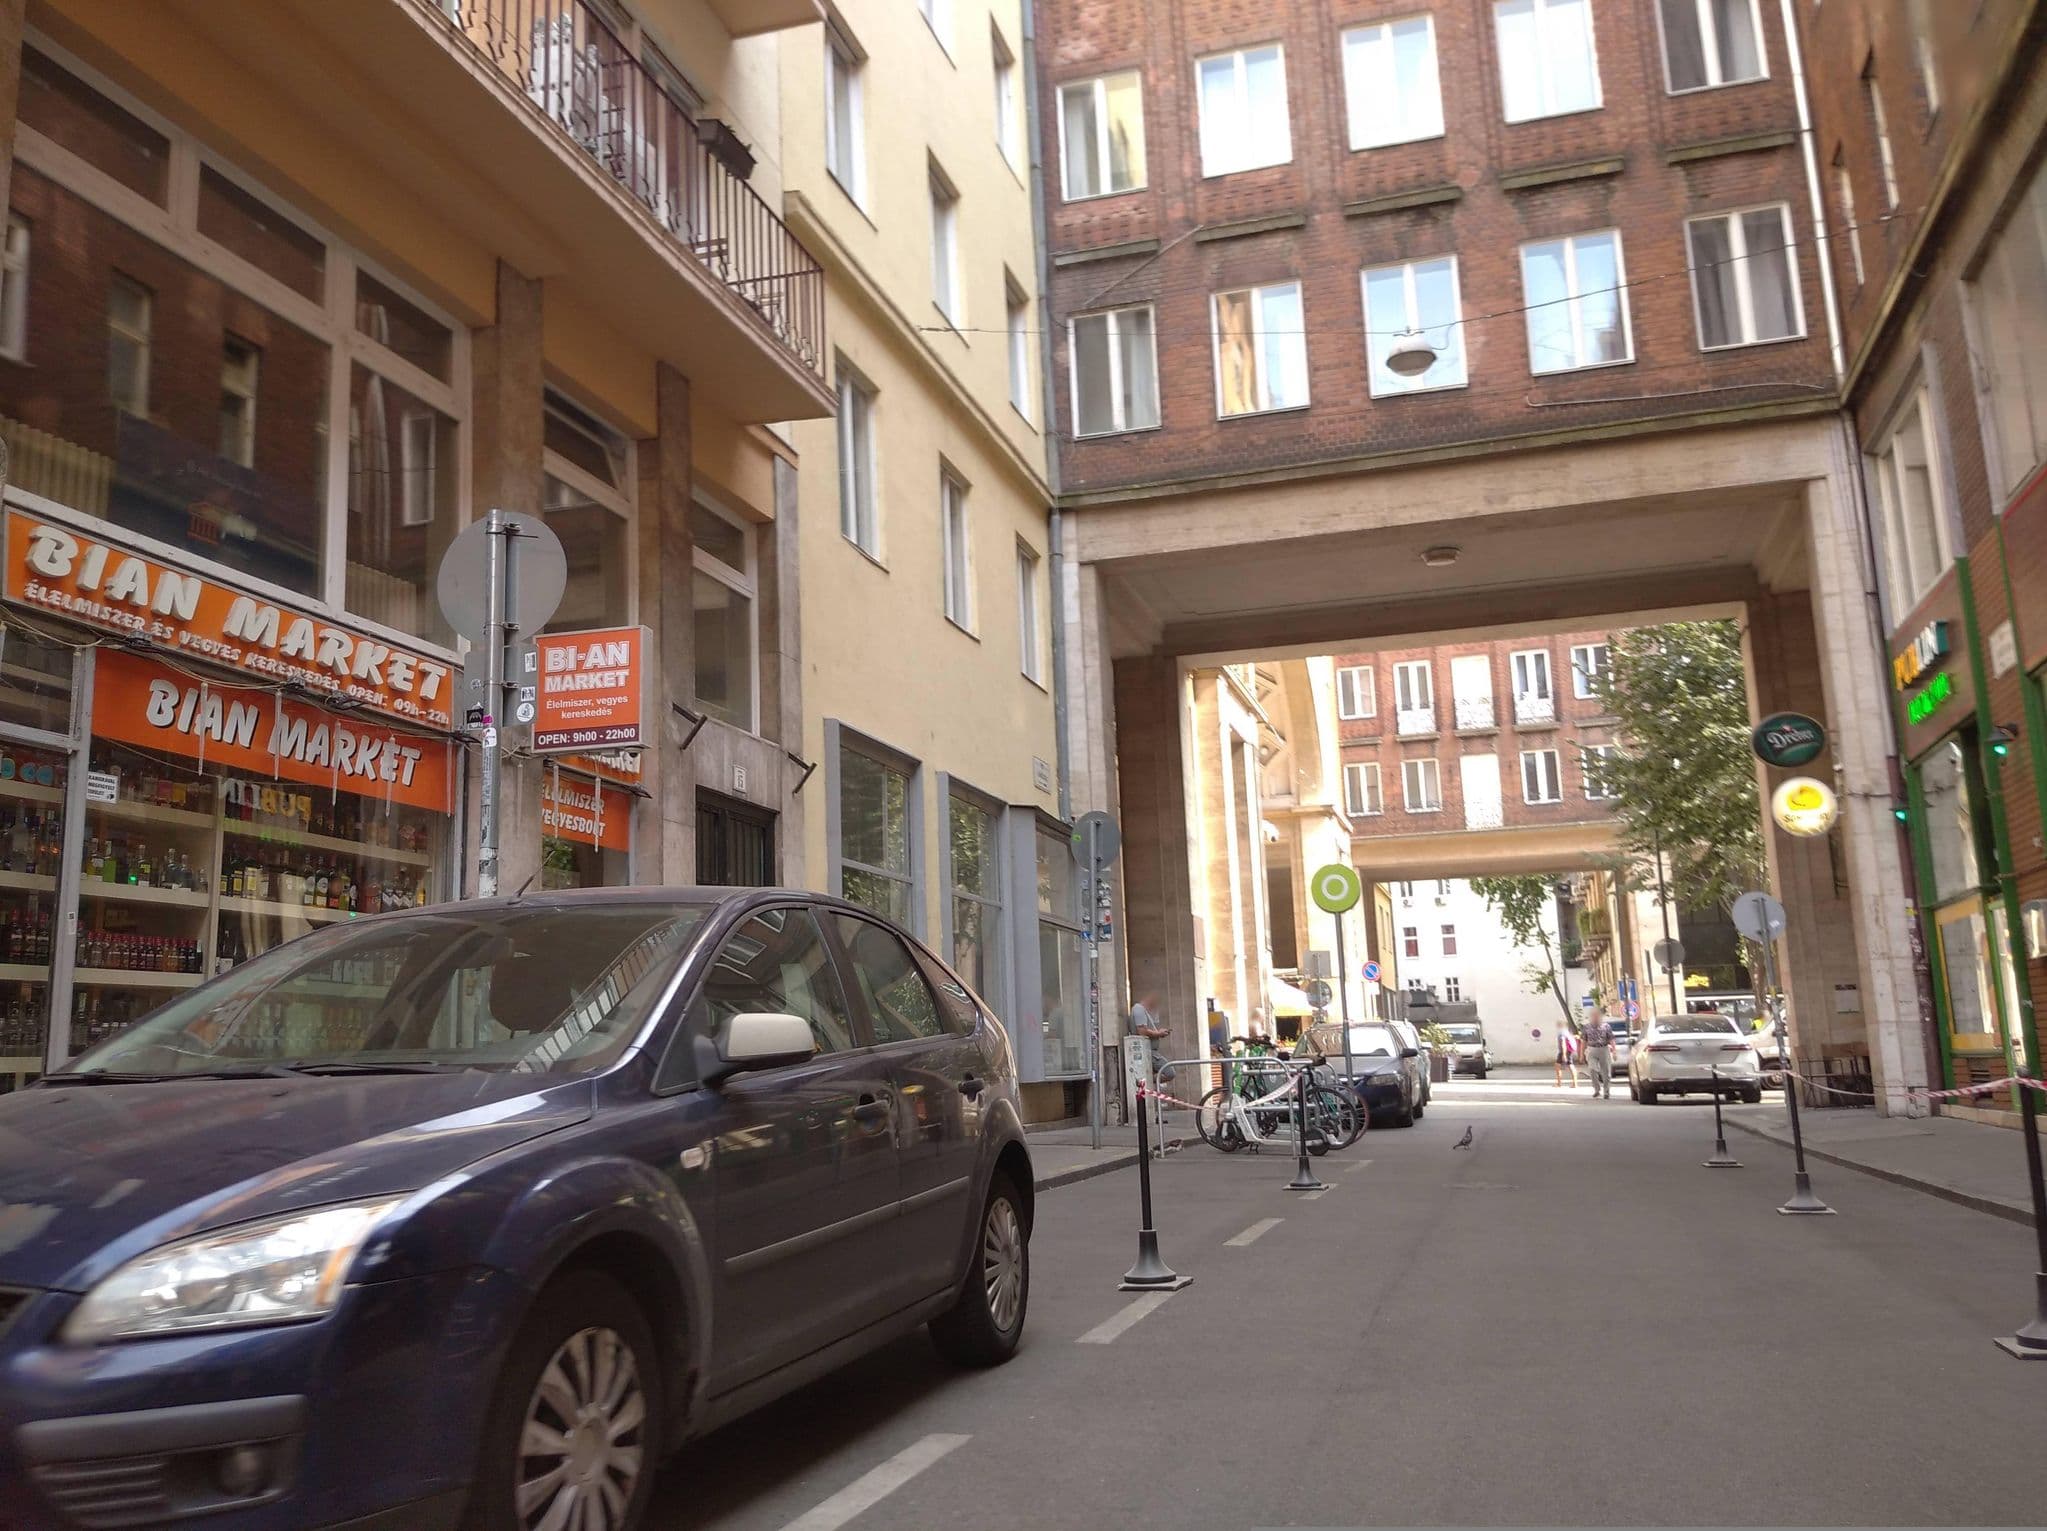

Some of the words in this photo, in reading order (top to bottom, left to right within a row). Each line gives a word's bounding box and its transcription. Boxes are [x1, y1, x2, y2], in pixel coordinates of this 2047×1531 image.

[25, 525, 202, 621] BIAN
[222, 596, 447, 700] MARKET
[544, 641, 630, 673] BI-AN
[544, 669, 630, 693] MARKET
[596, 695, 628, 706] vegyes
[146, 679, 258, 748] BIAN
[268, 711, 421, 787] MARKET
[538, 733, 571, 745] OPEN:
[573, 731, 597, 743] 9h00
[605, 728, 636, 740] 22h00
[542, 784, 605, 815] LLMISZER
[541, 808, 606, 837] EGYESBOLT
